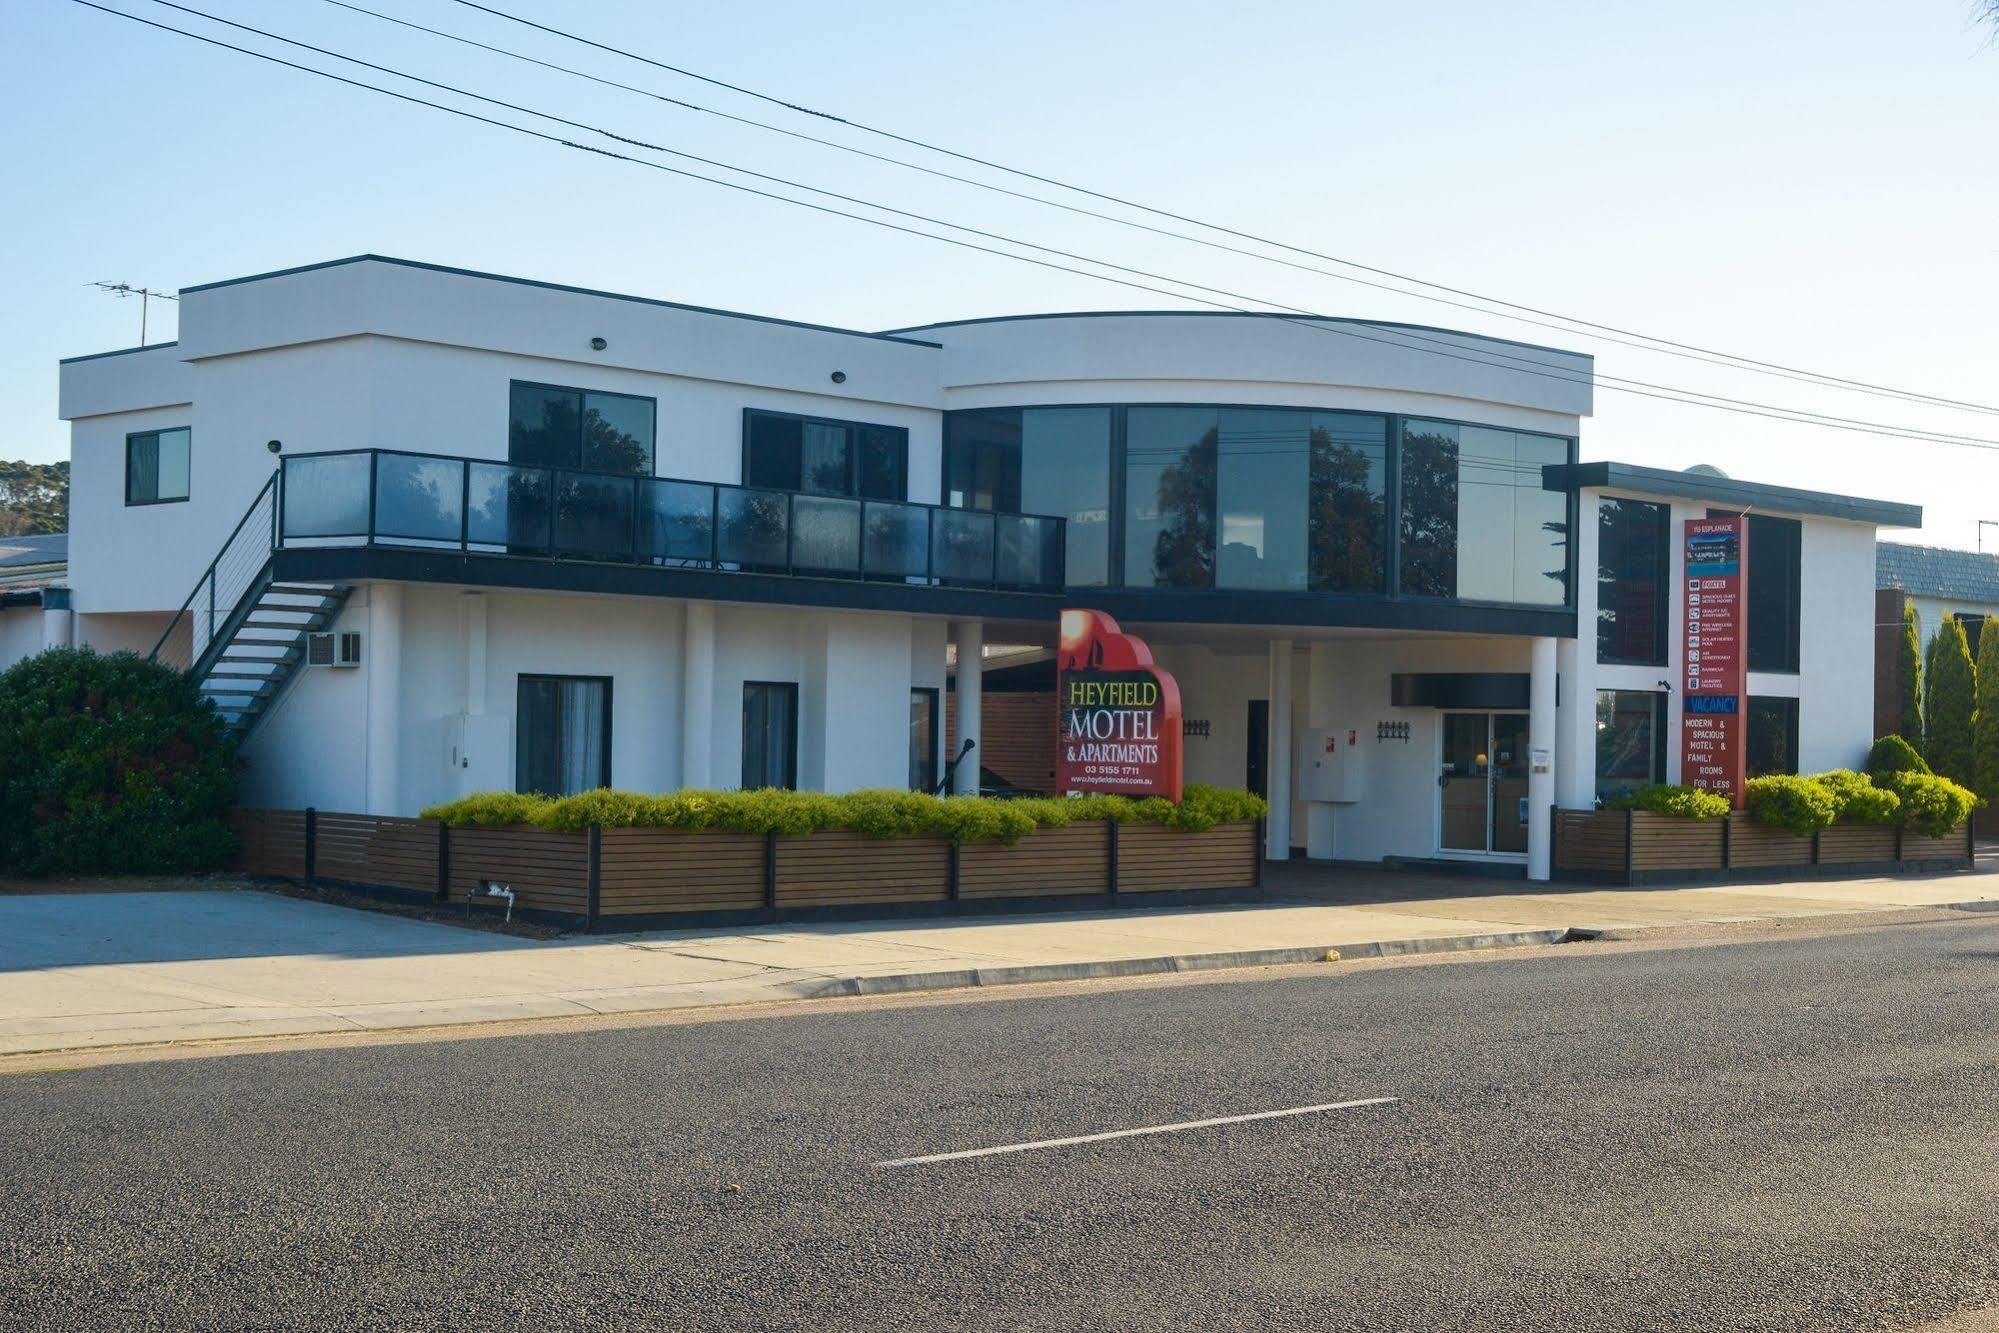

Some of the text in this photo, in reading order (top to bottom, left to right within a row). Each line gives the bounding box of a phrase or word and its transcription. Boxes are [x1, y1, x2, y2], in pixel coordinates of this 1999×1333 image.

[1702, 524, 1732, 533] ESPLANADE
[1070, 682, 1157, 706] HEYFIELD
[1691, 696, 1736, 713] VACANCY
[1069, 709, 1158, 740] MOTEL
[1686, 719, 1712, 727] MODERN
[1693, 731, 1724, 739] SPACIOUS
[1690, 742, 1726, 750] MOTEL &
[1067, 743, 1158, 764] & APARTMENTS
[1687, 754, 1712, 762] FAMILY
[1085, 766, 1140, 775] 03 5155 1711
[1700, 767, 1723, 775] ROOMS
[1694, 779, 1730, 788] FOR LESS
